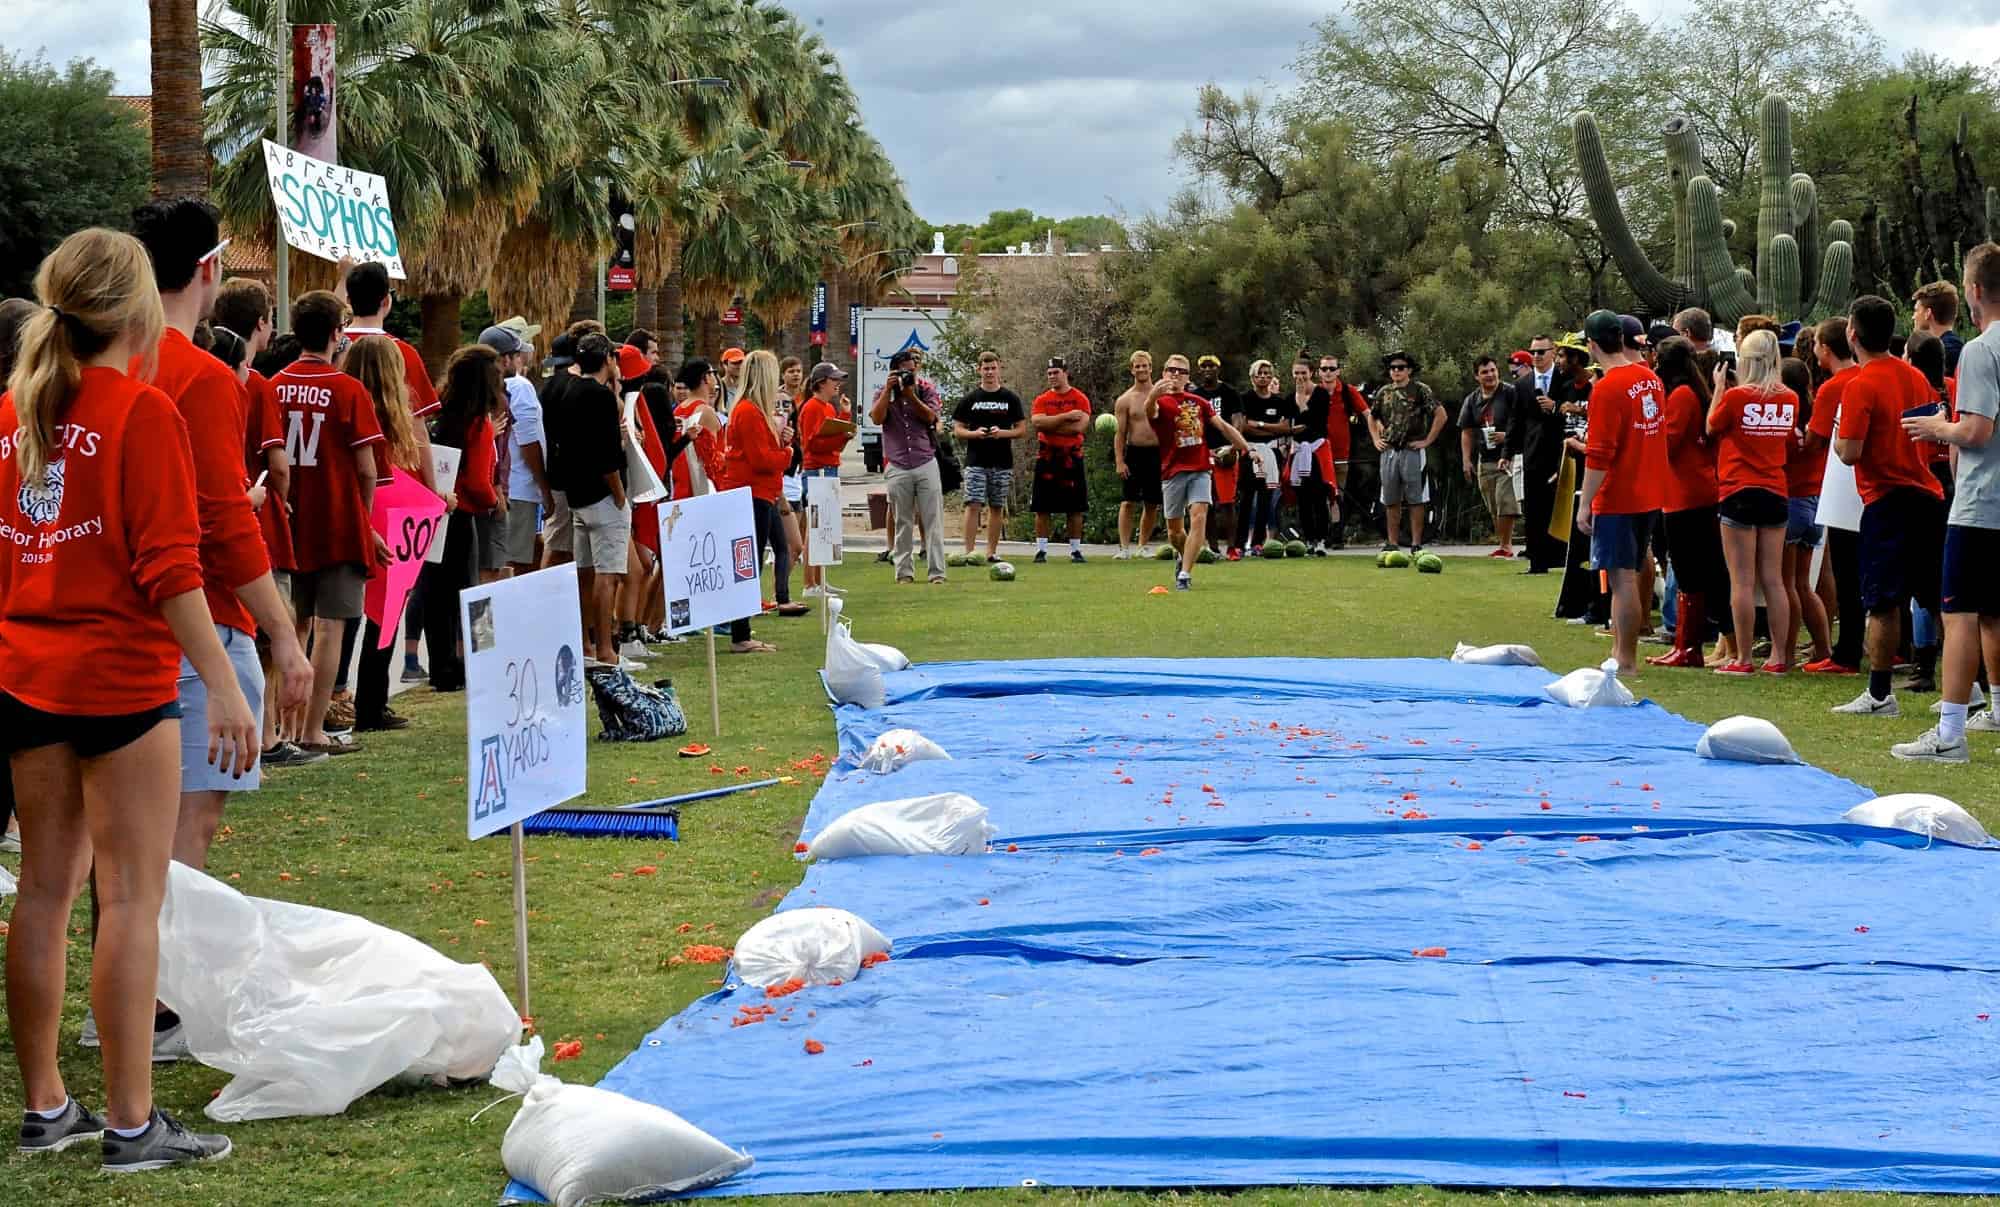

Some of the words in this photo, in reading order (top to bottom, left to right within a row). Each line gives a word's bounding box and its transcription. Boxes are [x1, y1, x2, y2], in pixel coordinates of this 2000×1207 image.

[282, 173, 398, 257] SOPHOS
[276, 385, 332, 407] OPHOS
[689, 531, 717, 568] 20
[685, 565, 725, 596] YARDS
[505, 658, 538, 727] 30
[501, 717, 550, 781] YARDS
